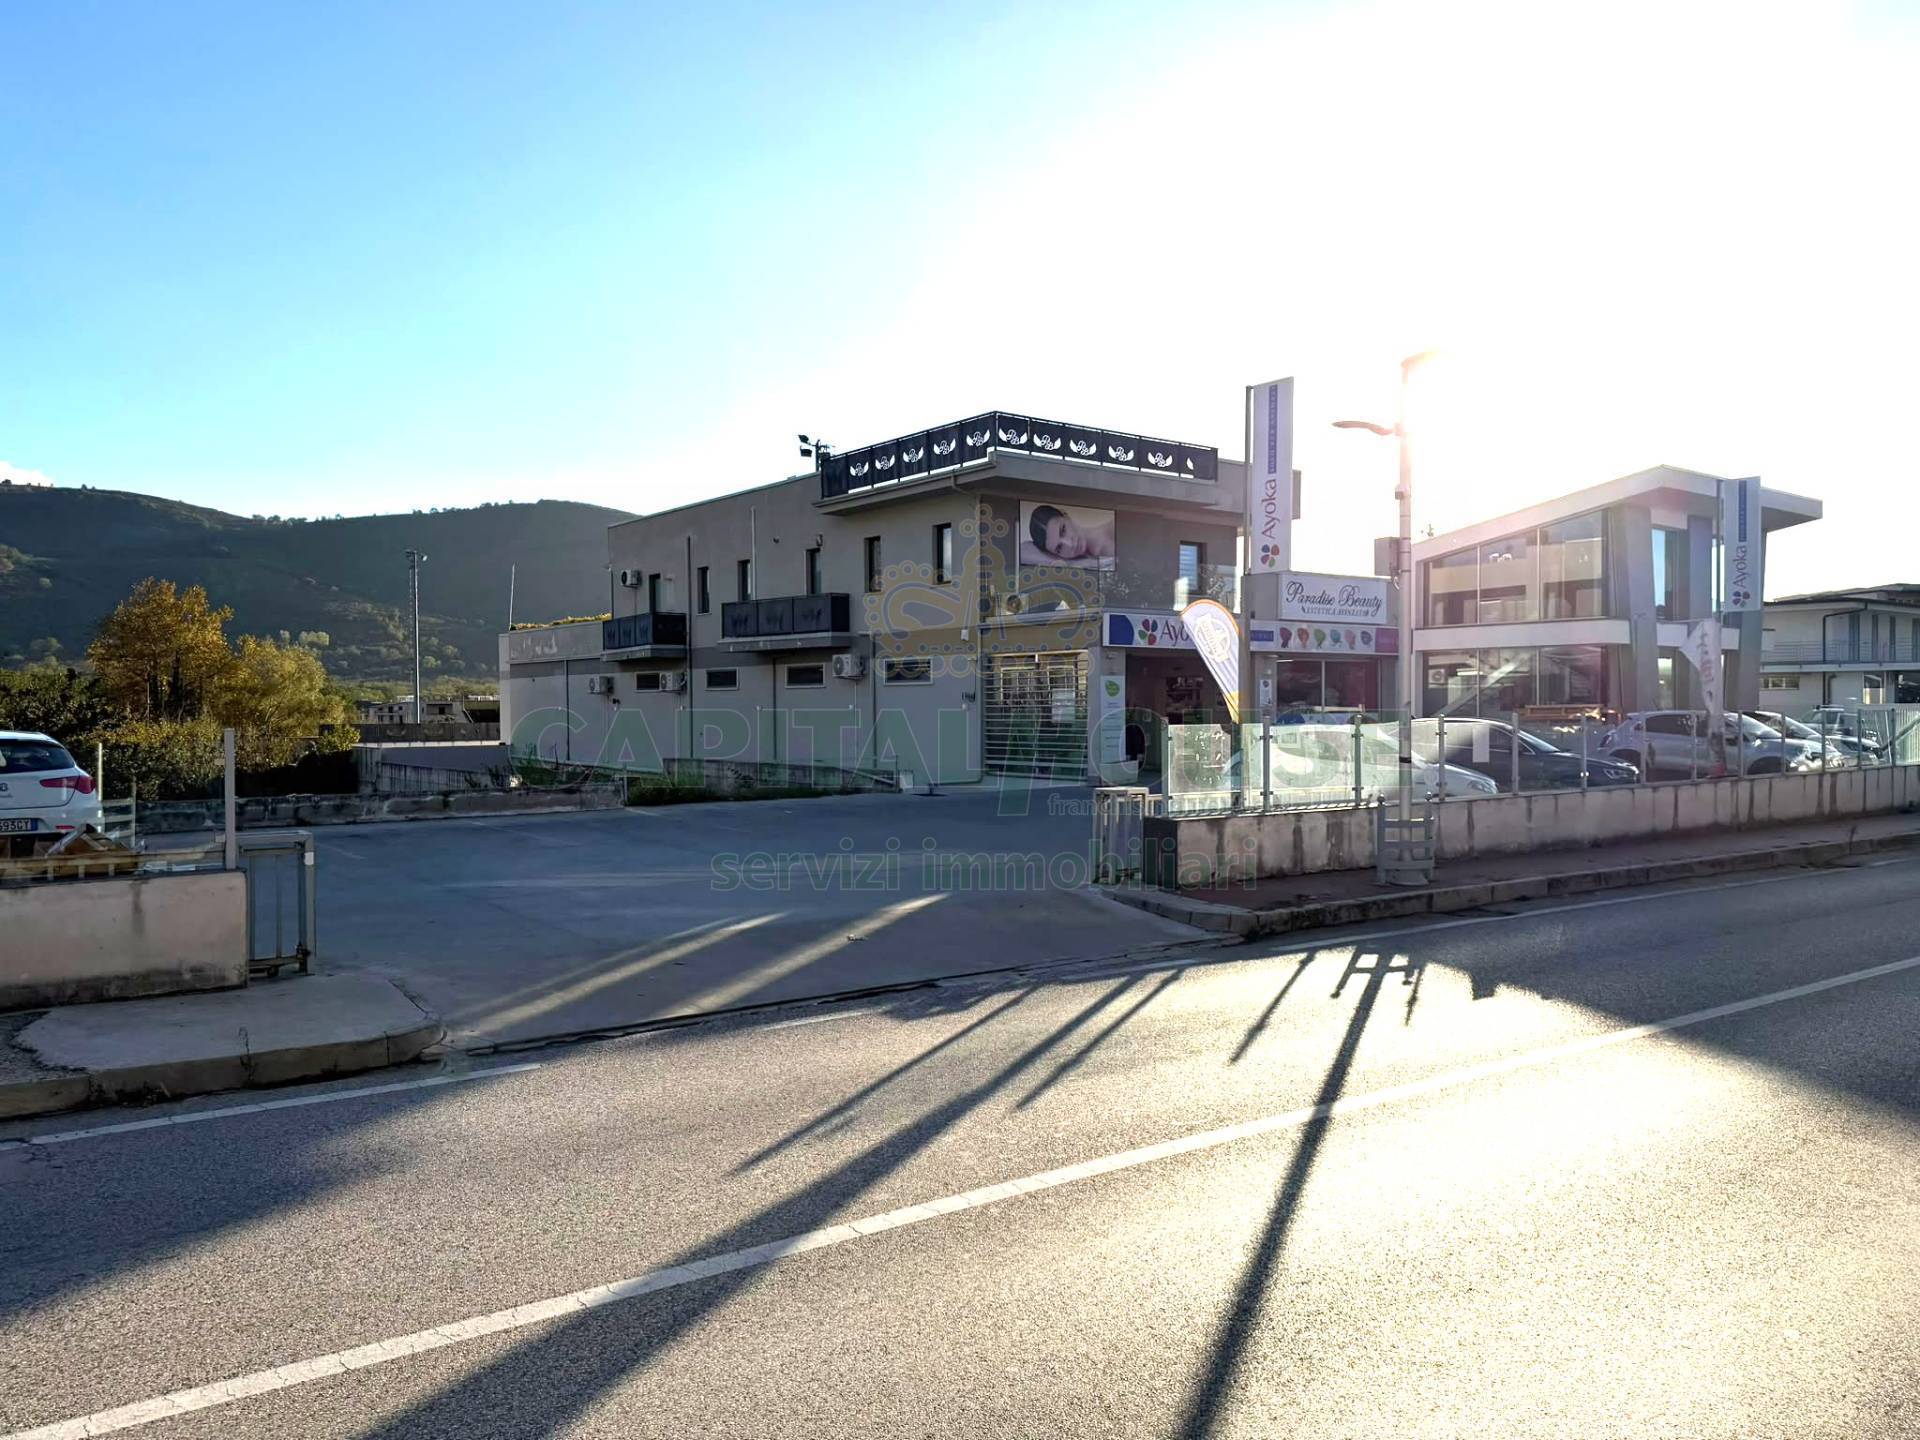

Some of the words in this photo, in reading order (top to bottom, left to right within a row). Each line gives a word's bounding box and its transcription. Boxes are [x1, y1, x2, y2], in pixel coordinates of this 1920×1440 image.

[1261, 478, 1281, 540] Ayoka
[1732, 545, 1750, 588] Ayoka
[1285, 580, 1336, 606] Paradise
[1337, 584, 1383, 617] Beauty
